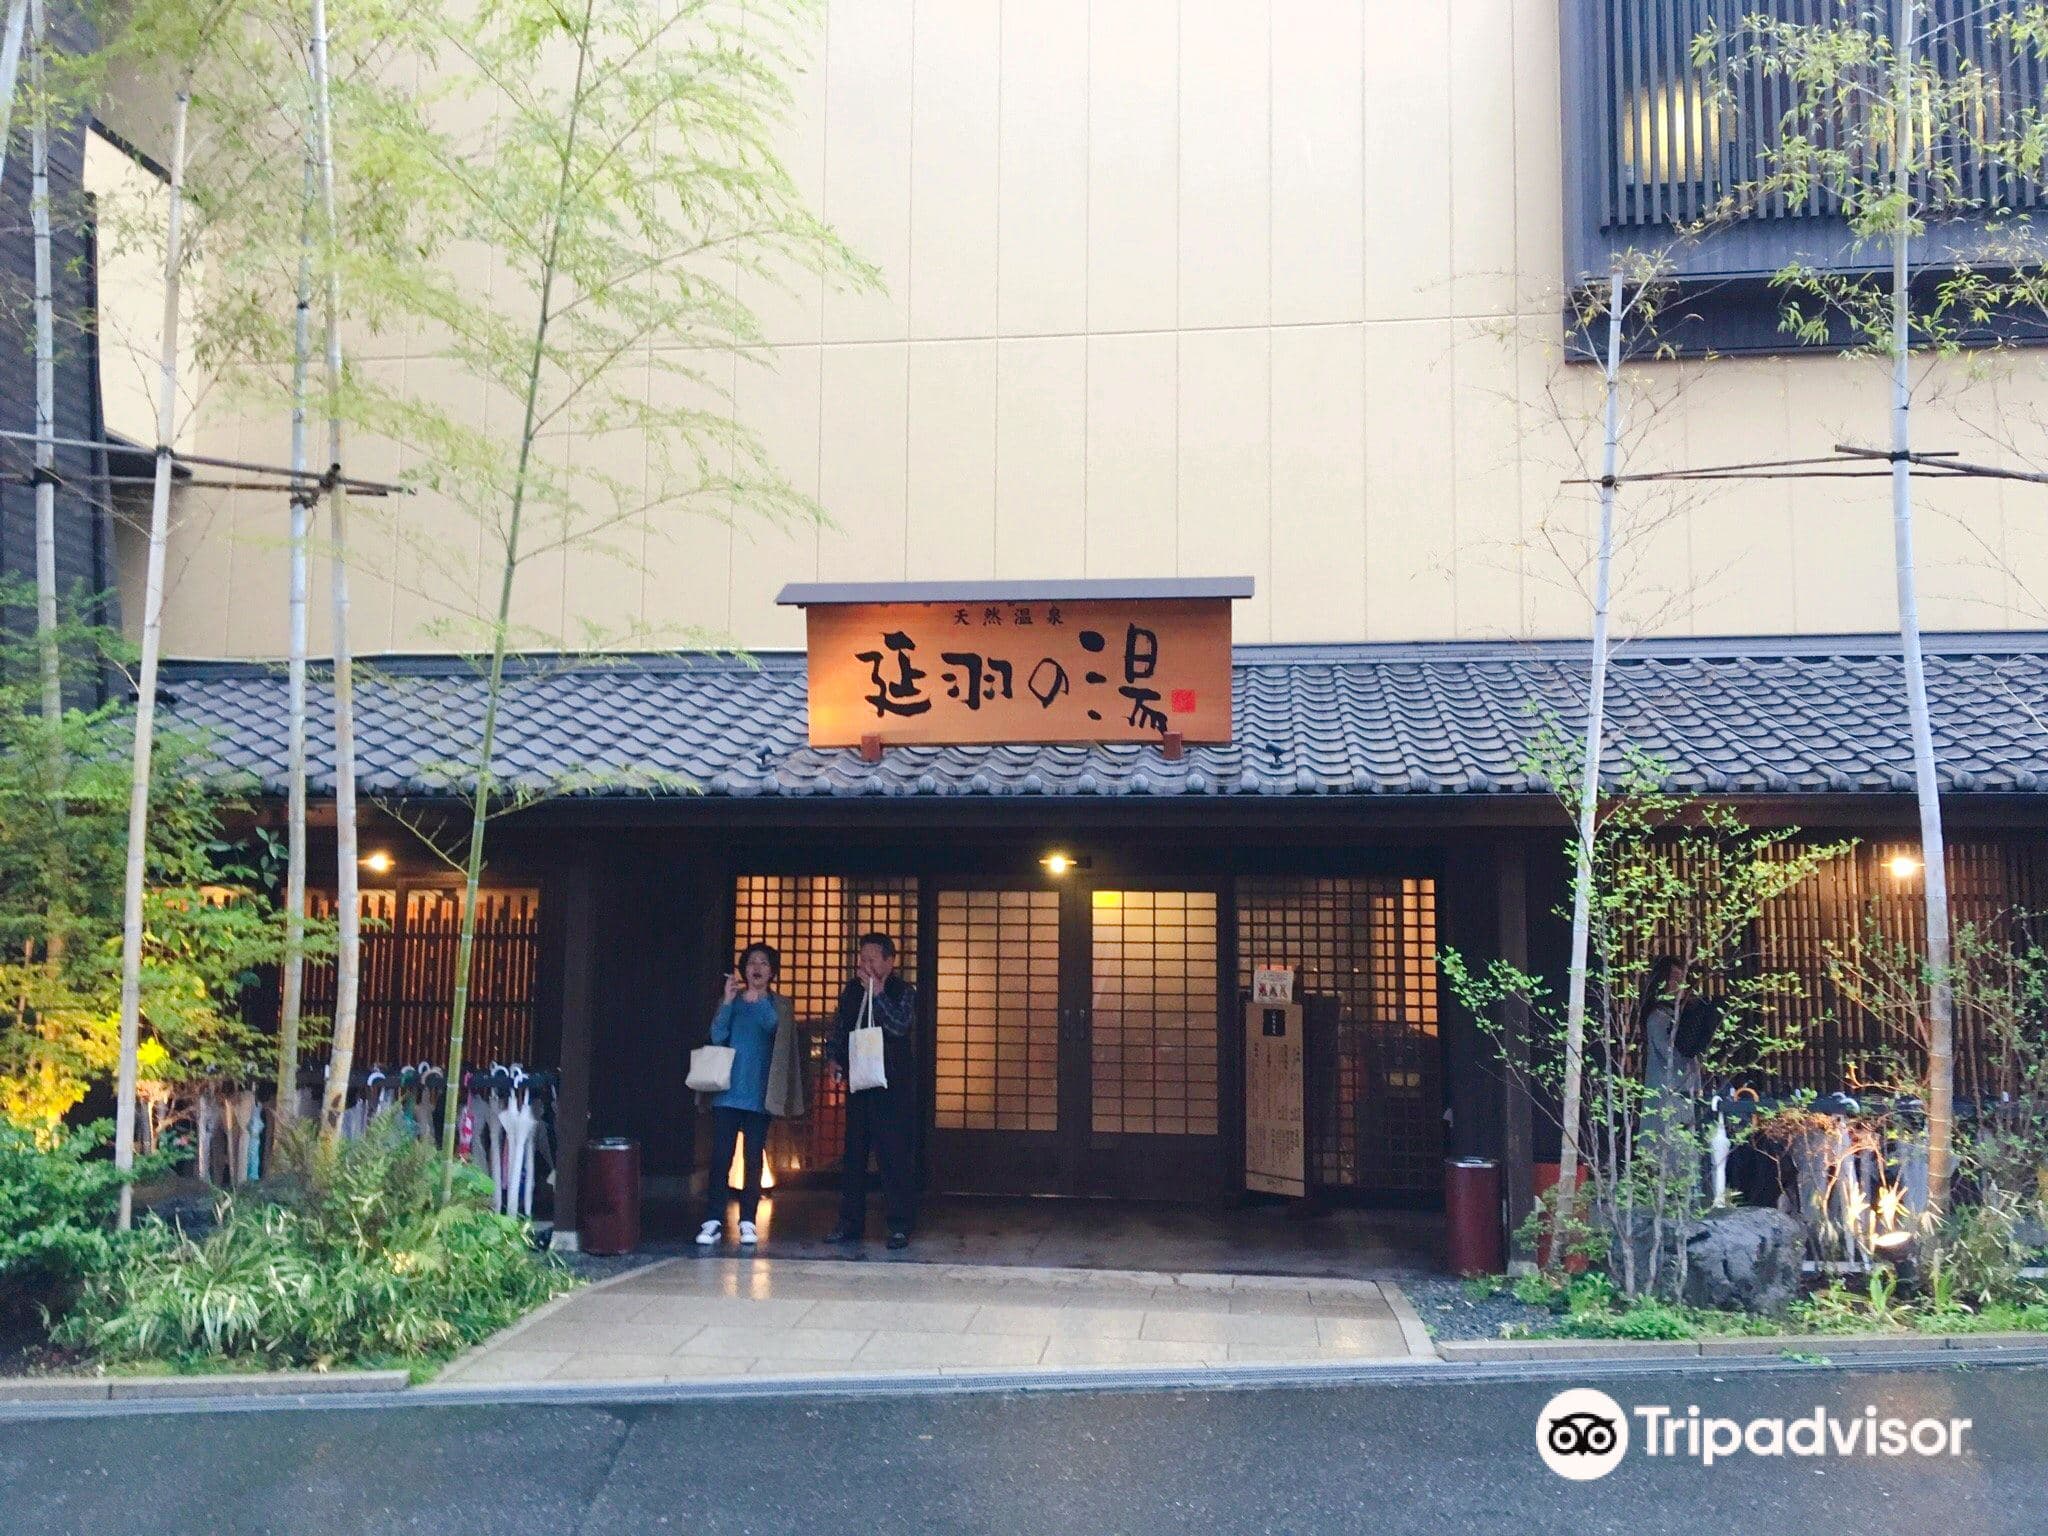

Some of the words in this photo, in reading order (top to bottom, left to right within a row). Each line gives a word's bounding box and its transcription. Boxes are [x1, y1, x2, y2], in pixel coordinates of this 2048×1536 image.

[953, 607, 1065, 626] 天然温泉
[854, 622, 1168, 734] 延羽の湯
